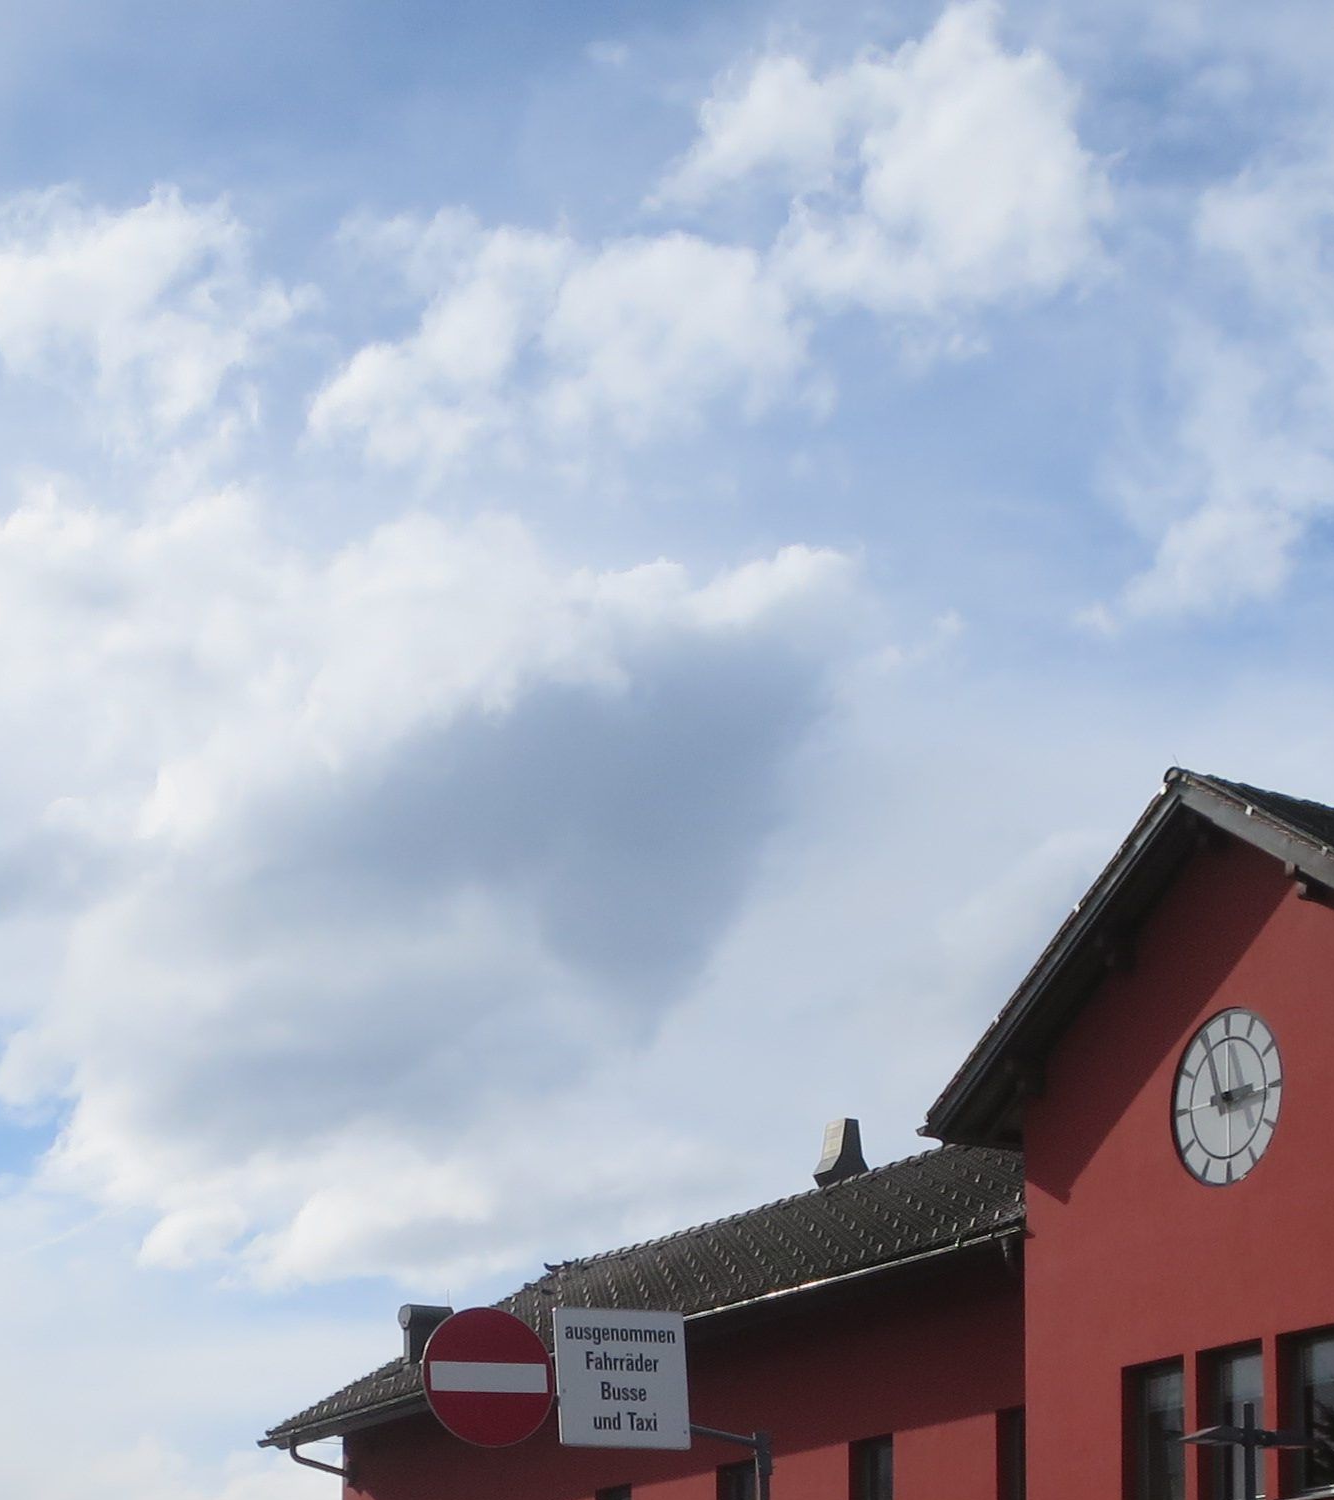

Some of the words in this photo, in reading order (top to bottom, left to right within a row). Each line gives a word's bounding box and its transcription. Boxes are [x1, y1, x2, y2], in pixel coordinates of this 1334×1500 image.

[565, 1325, 676, 1345] ausgenommen
[585, 1351, 659, 1373] Fahrräder
[600, 1381, 647, 1402] Busse
[593, 1412, 622, 1431] und
[626, 1411, 658, 1432] Taxi
